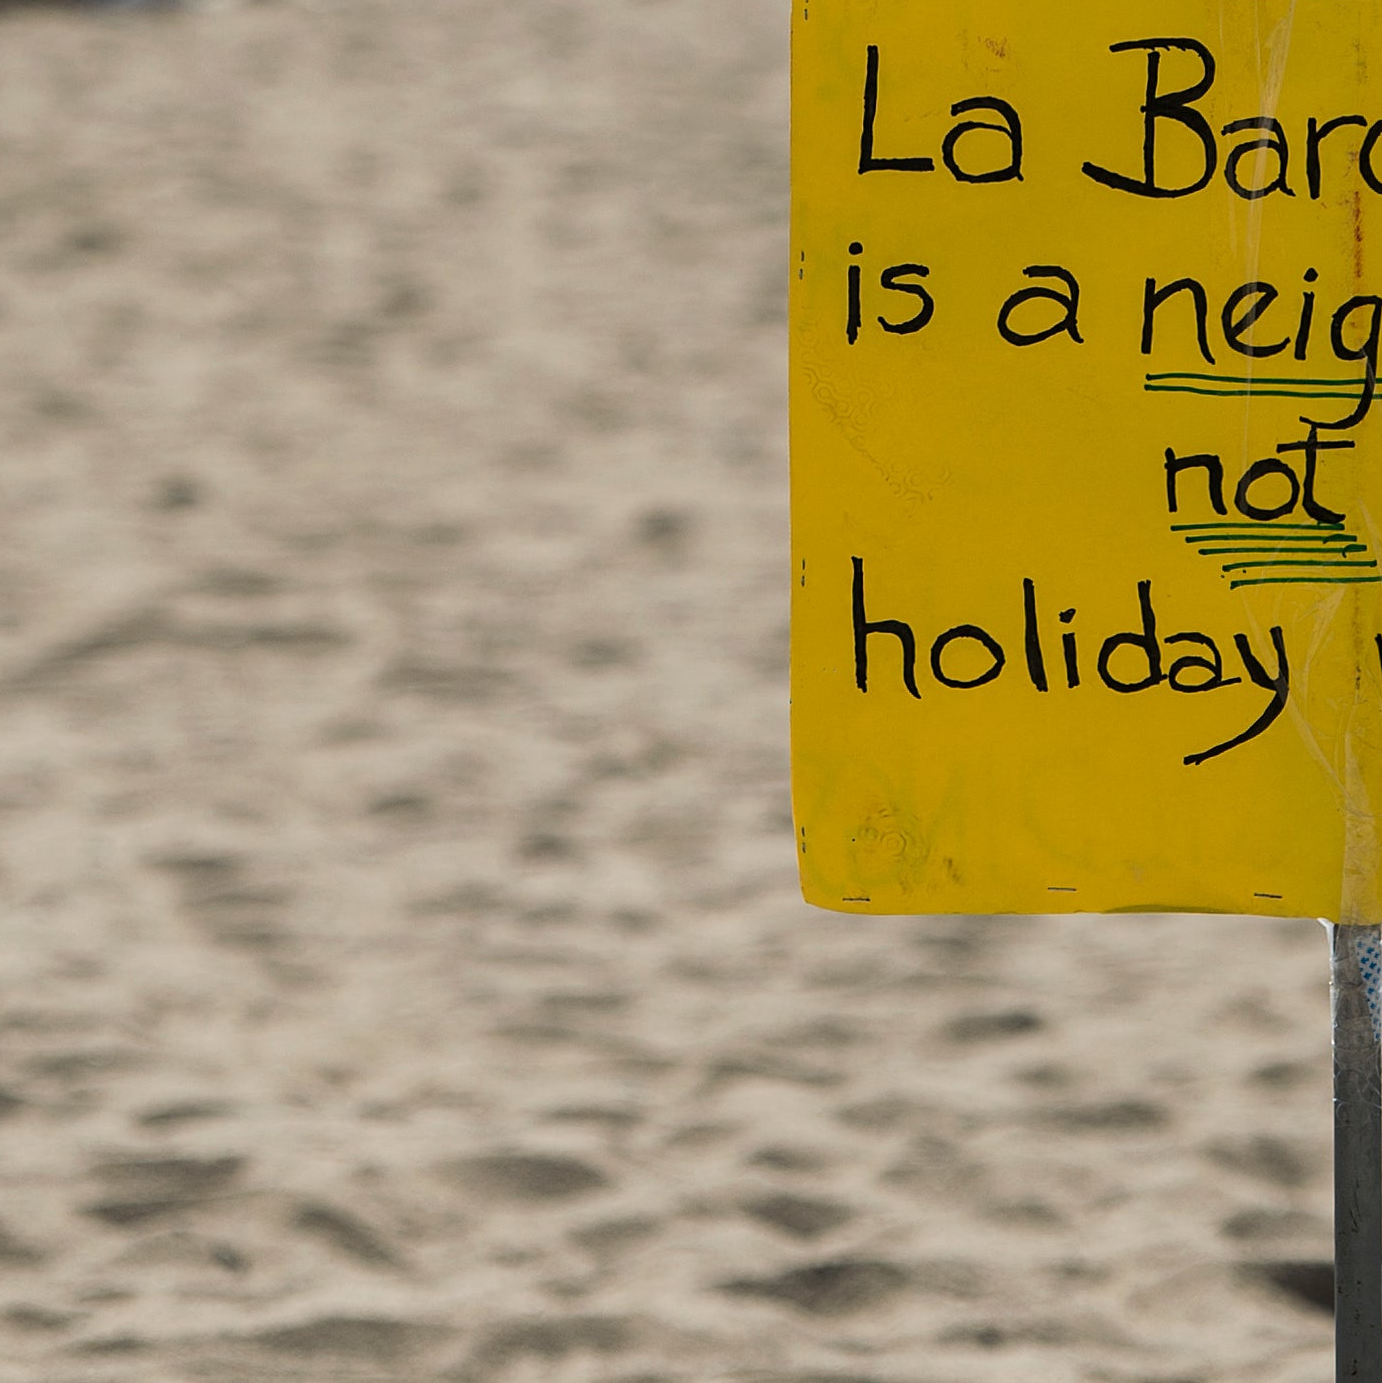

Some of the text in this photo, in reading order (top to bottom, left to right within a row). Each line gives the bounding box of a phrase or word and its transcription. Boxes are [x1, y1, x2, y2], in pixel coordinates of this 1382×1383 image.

[857, 44, 1025, 184] La
[845, 242, 935, 346] is
[996, 264, 1085, 348] a
[1163, 424, 1355, 524] not
[850, 555, 1290, 766] holiday
